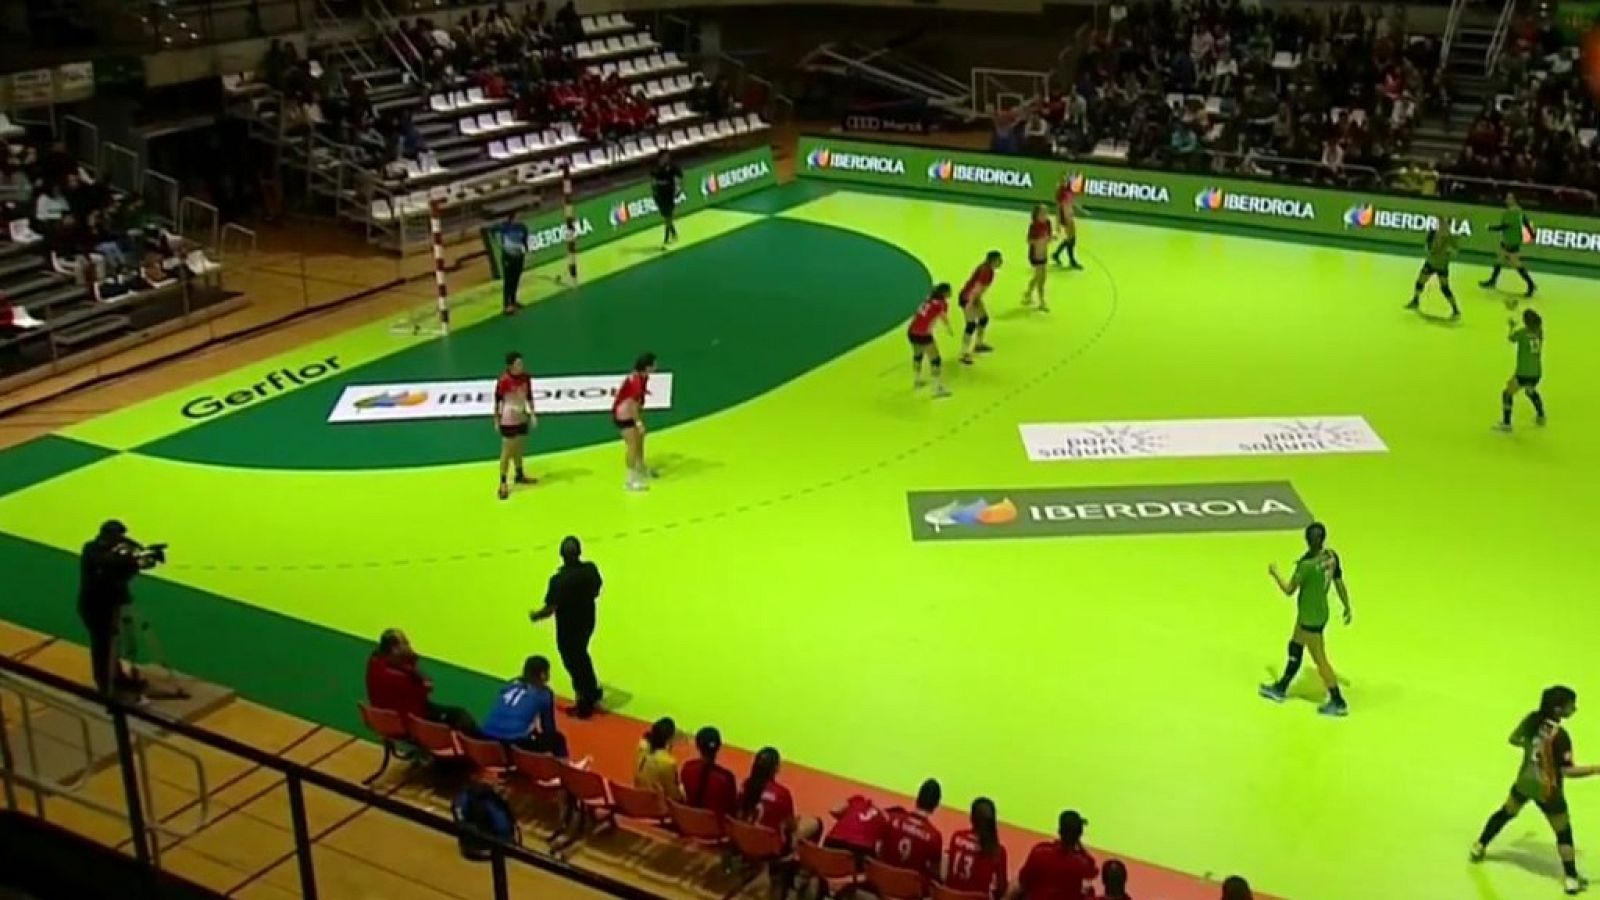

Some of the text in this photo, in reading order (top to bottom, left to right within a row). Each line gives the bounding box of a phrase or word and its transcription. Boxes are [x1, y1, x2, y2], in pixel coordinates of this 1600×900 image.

[718, 160, 769, 188] IBERDROLA
[831, 152, 905, 174] IBERDROLA
[952, 164, 1033, 188] IBERDROLA
[1084, 179, 1169, 202] IBERDROLA
[1223, 192, 1315, 219] IBERDROLA
[1374, 210, 1473, 236] IBERDRLA
[181, 355, 341, 419] Gerflor
[1030, 498, 1296, 522] IBERDROLA
[503, 687, 526, 705] 41
[898, 838, 912, 862] 9
[953, 851, 975, 881] 13
